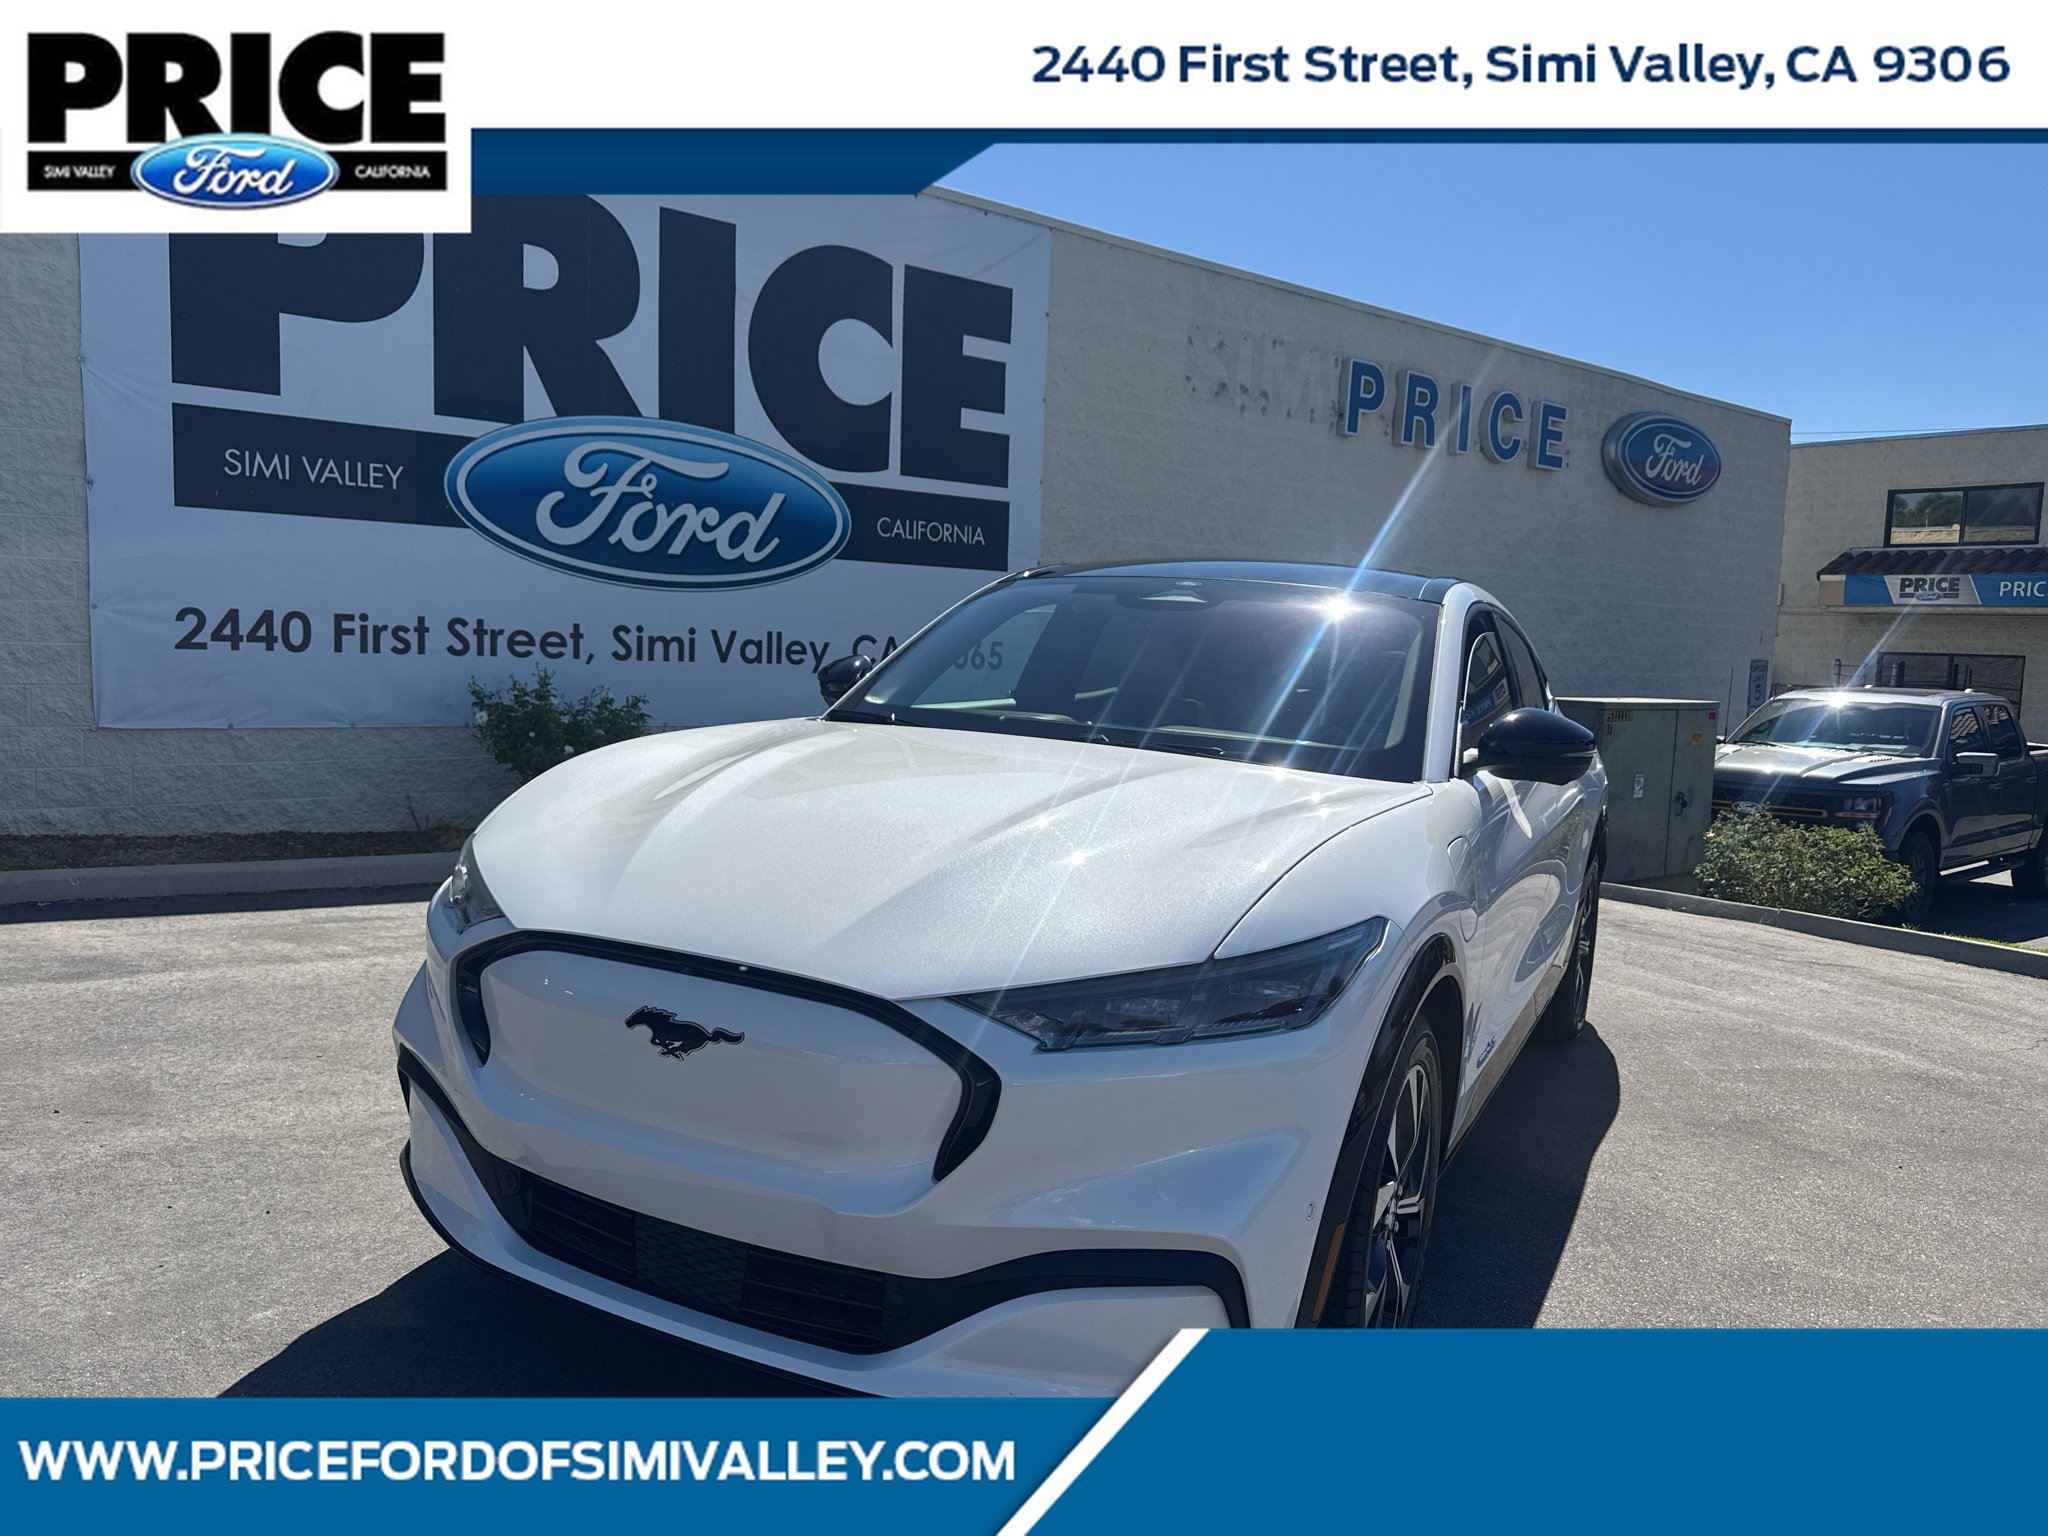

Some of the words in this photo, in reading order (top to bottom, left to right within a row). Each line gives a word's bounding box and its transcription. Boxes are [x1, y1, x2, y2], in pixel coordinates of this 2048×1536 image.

[169, 195, 1013, 488] PRICE
[1345, 357, 1568, 471] PRICE
[223, 448, 290, 480] SIMI
[302, 456, 404, 490] VALLEY
[1645, 432, 1704, 487] Ford
[536, 440, 786, 563] Ford
[876, 516, 986, 546] CALIFORNIA
[1899, 577, 1961, 593] PRICE
[1999, 580, 2048, 597] PRIC
[174, 606, 312, 653] 2440
[333, 612, 430, 655] First
[446, 615, 595, 665] Street,
[611, 624, 696, 662] Simi
